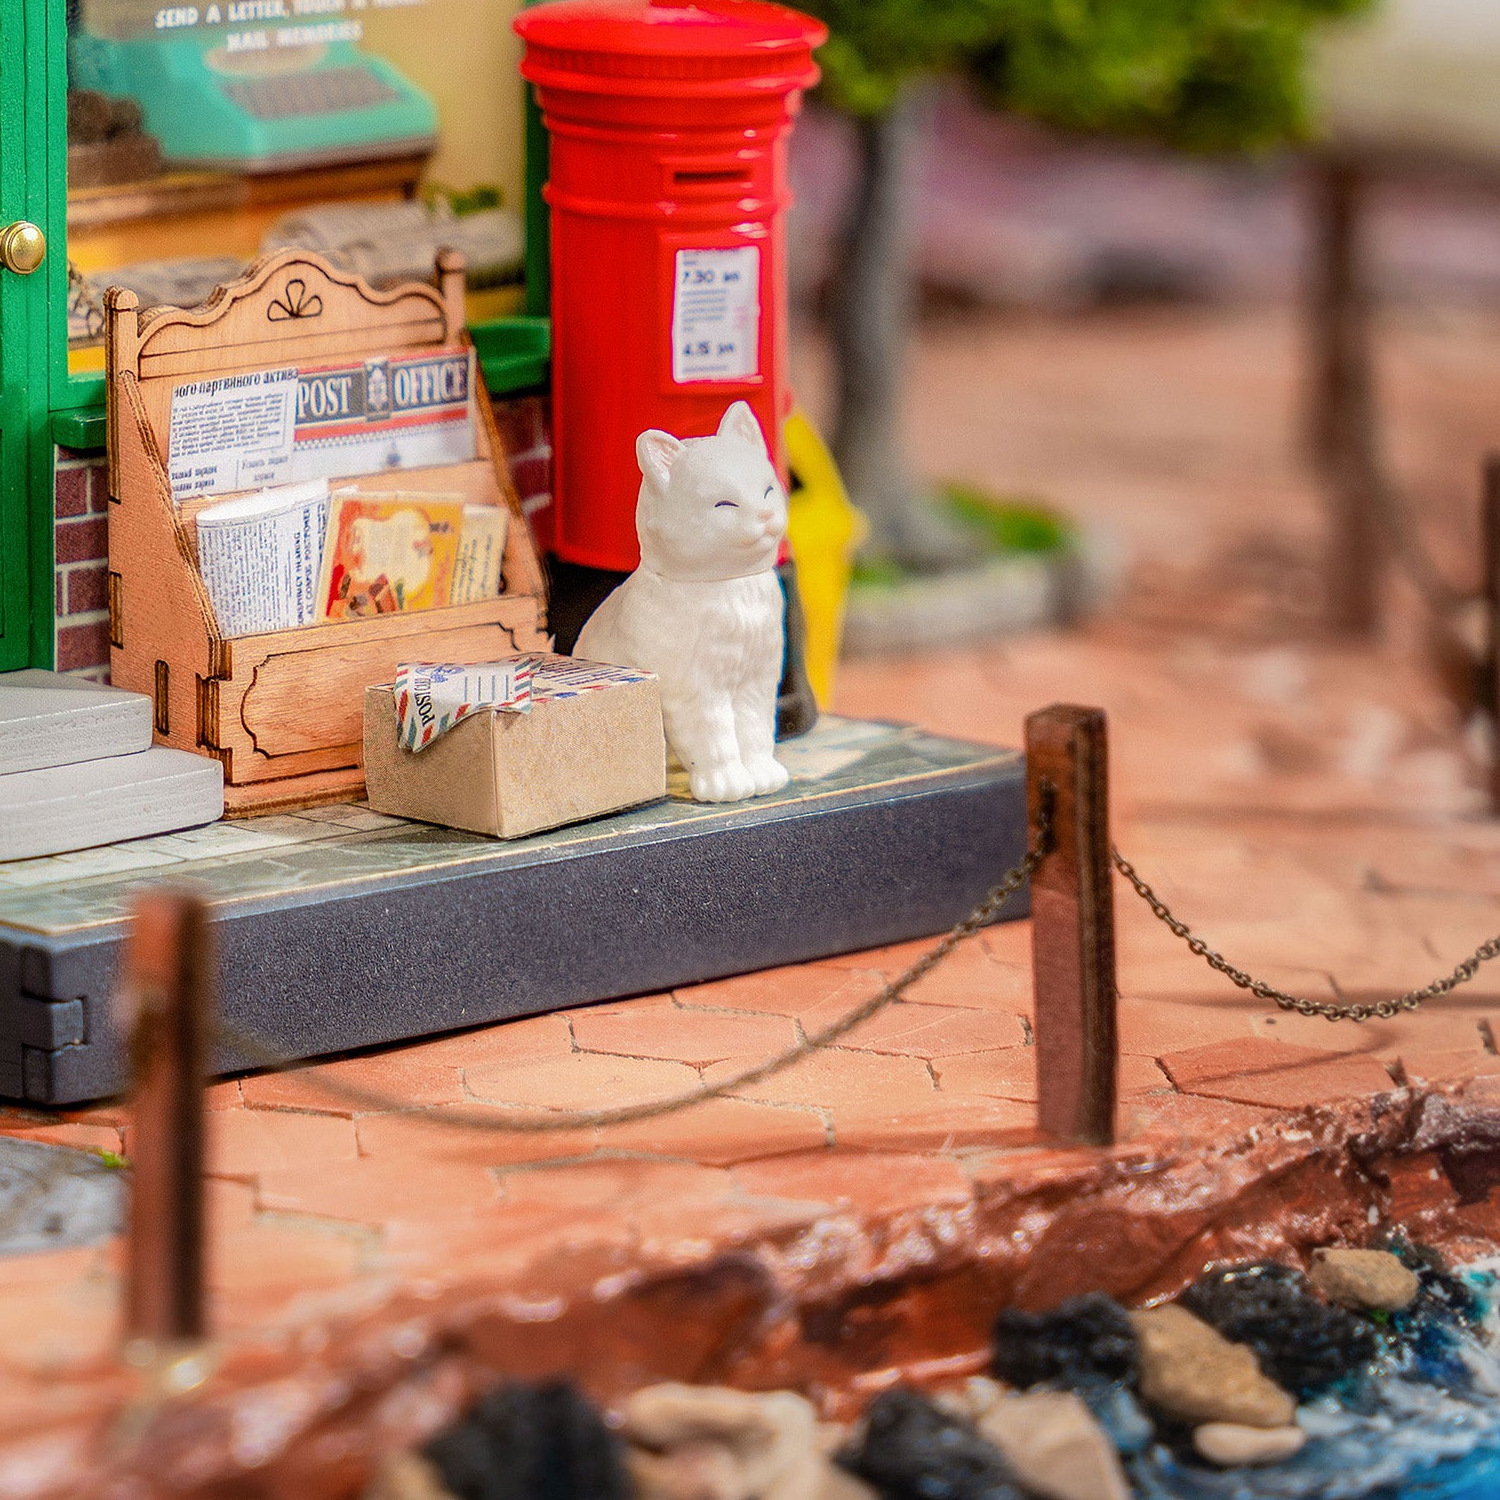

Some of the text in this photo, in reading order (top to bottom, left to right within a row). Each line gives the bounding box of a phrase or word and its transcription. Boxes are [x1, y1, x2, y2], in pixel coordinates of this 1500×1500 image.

[155, 6, 200, 29] SEND
[205, 3, 222, 24] A
[297, 360, 467, 420] POST OFFICE
[414, 692, 436, 727] POST
